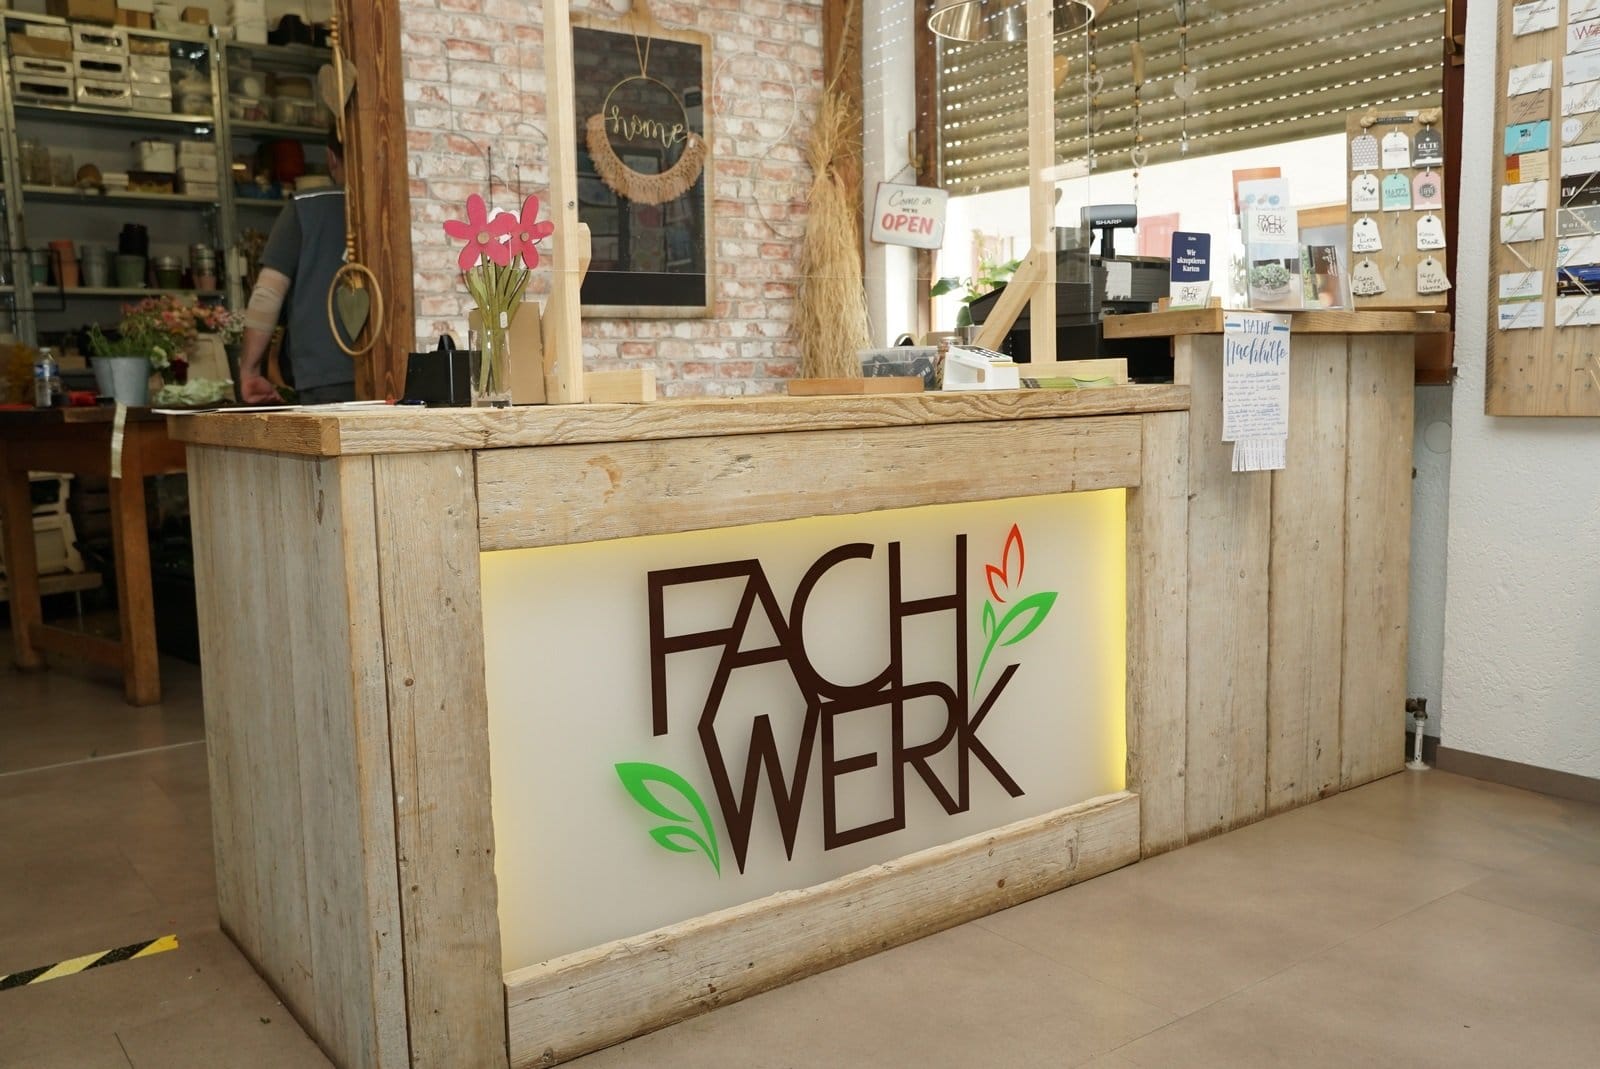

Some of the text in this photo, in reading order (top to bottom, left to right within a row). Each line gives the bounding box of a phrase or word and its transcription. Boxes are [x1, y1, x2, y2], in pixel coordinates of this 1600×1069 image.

[605, 105, 687, 148] home
[889, 190, 932, 207] Come in
[882, 213, 934, 235] OPEN
[1177, 257, 1206, 265] akzeptieren
[1243, 319, 1272, 335] MATHE
[1226, 338, 1288, 367] Nachhilfe
[648, 534, 968, 737] FACH
[697, 662, 1026, 875] WERK
